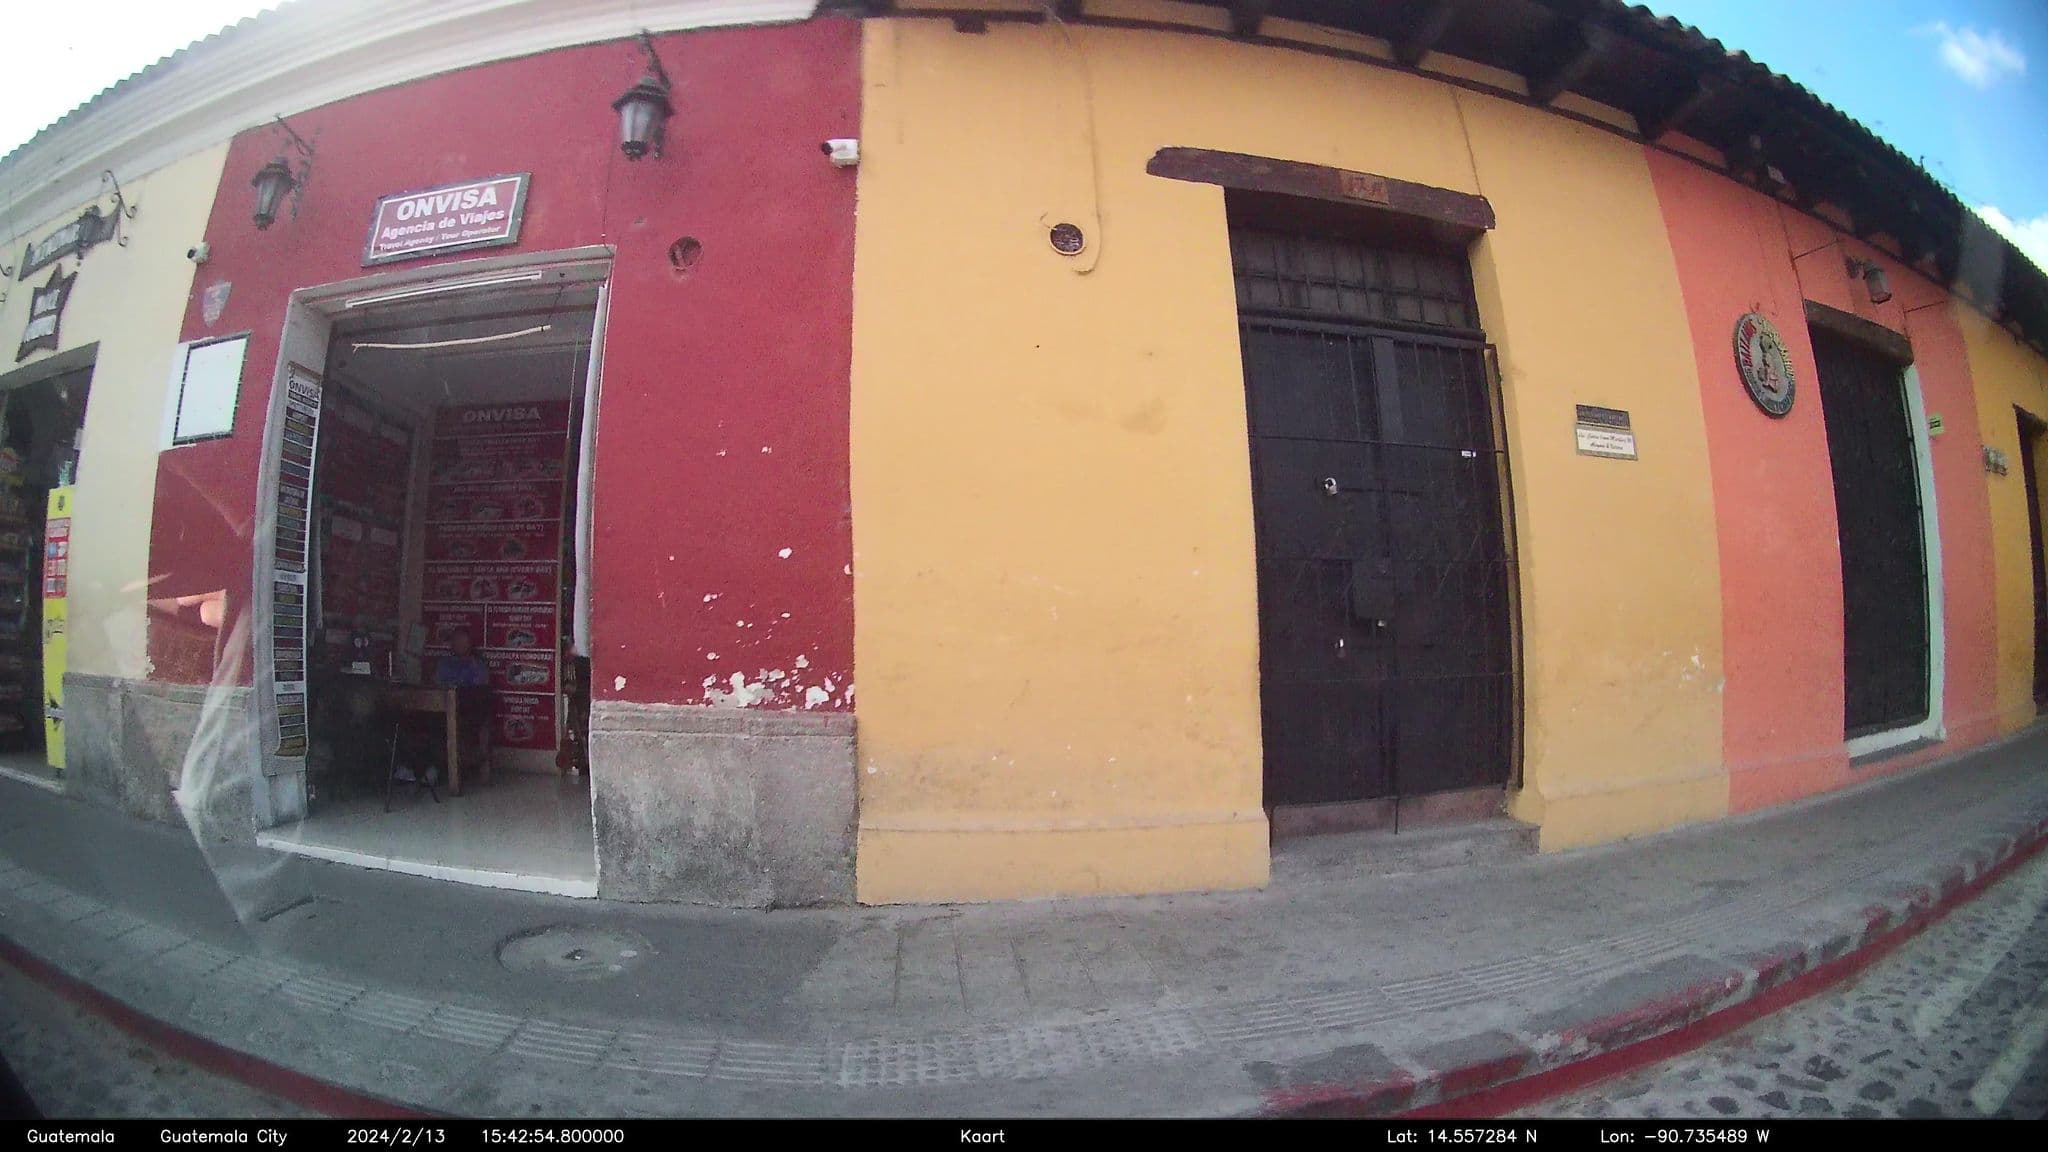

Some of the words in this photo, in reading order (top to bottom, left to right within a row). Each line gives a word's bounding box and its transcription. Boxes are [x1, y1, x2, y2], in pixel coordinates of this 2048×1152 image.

[396, 186, 497, 221] ONVISA
[381, 220, 435, 240] Agencia
[438, 217, 456, 229] de
[459, 209, 505, 226] Viajes
[379, 239, 403, 251] Travel
[403, 235, 435, 247] Agency
[441, 231, 460, 241] Tour
[461, 225, 502, 238] Operator
[288, 380, 320, 399] ONVISA
[463, 407, 541, 423] ONVISA
